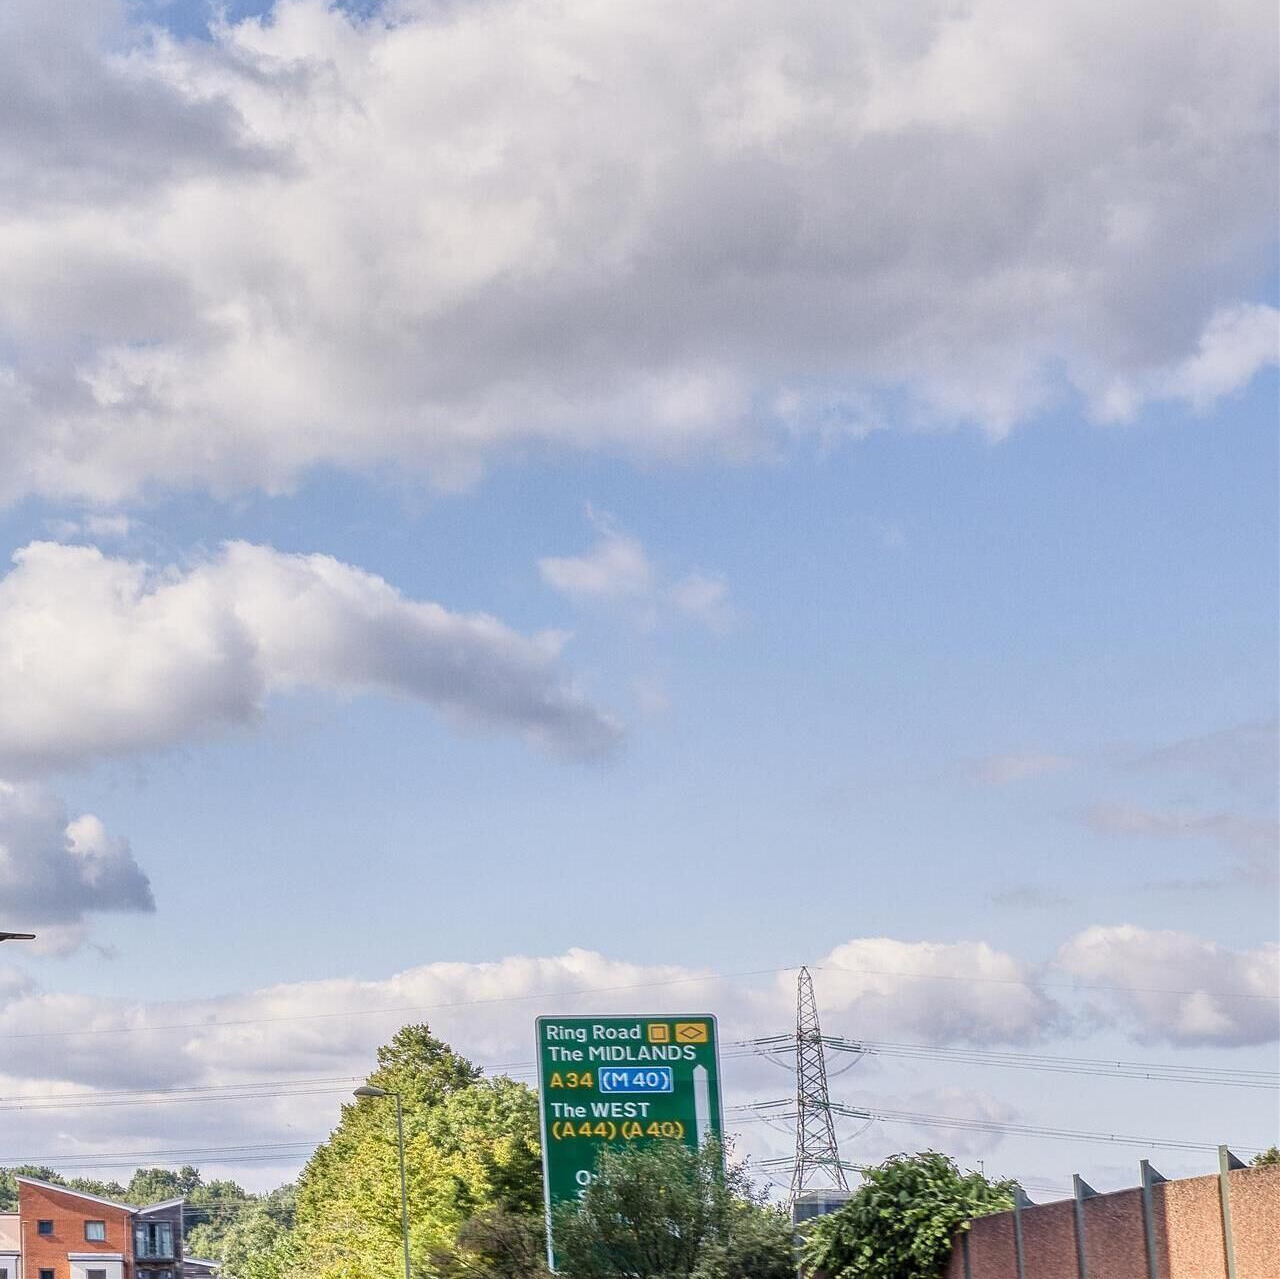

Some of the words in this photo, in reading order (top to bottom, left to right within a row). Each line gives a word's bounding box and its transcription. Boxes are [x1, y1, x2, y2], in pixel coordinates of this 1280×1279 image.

[546, 1025, 587, 1043] Ring
[592, 1024, 642, 1040] Road
[548, 1046, 584, 1061] The
[588, 1045, 697, 1061] MIDLANDS
[550, 1072, 593, 1088] A34
[550, 1102, 587, 1117] The
[590, 1102, 651, 1117] WEST
